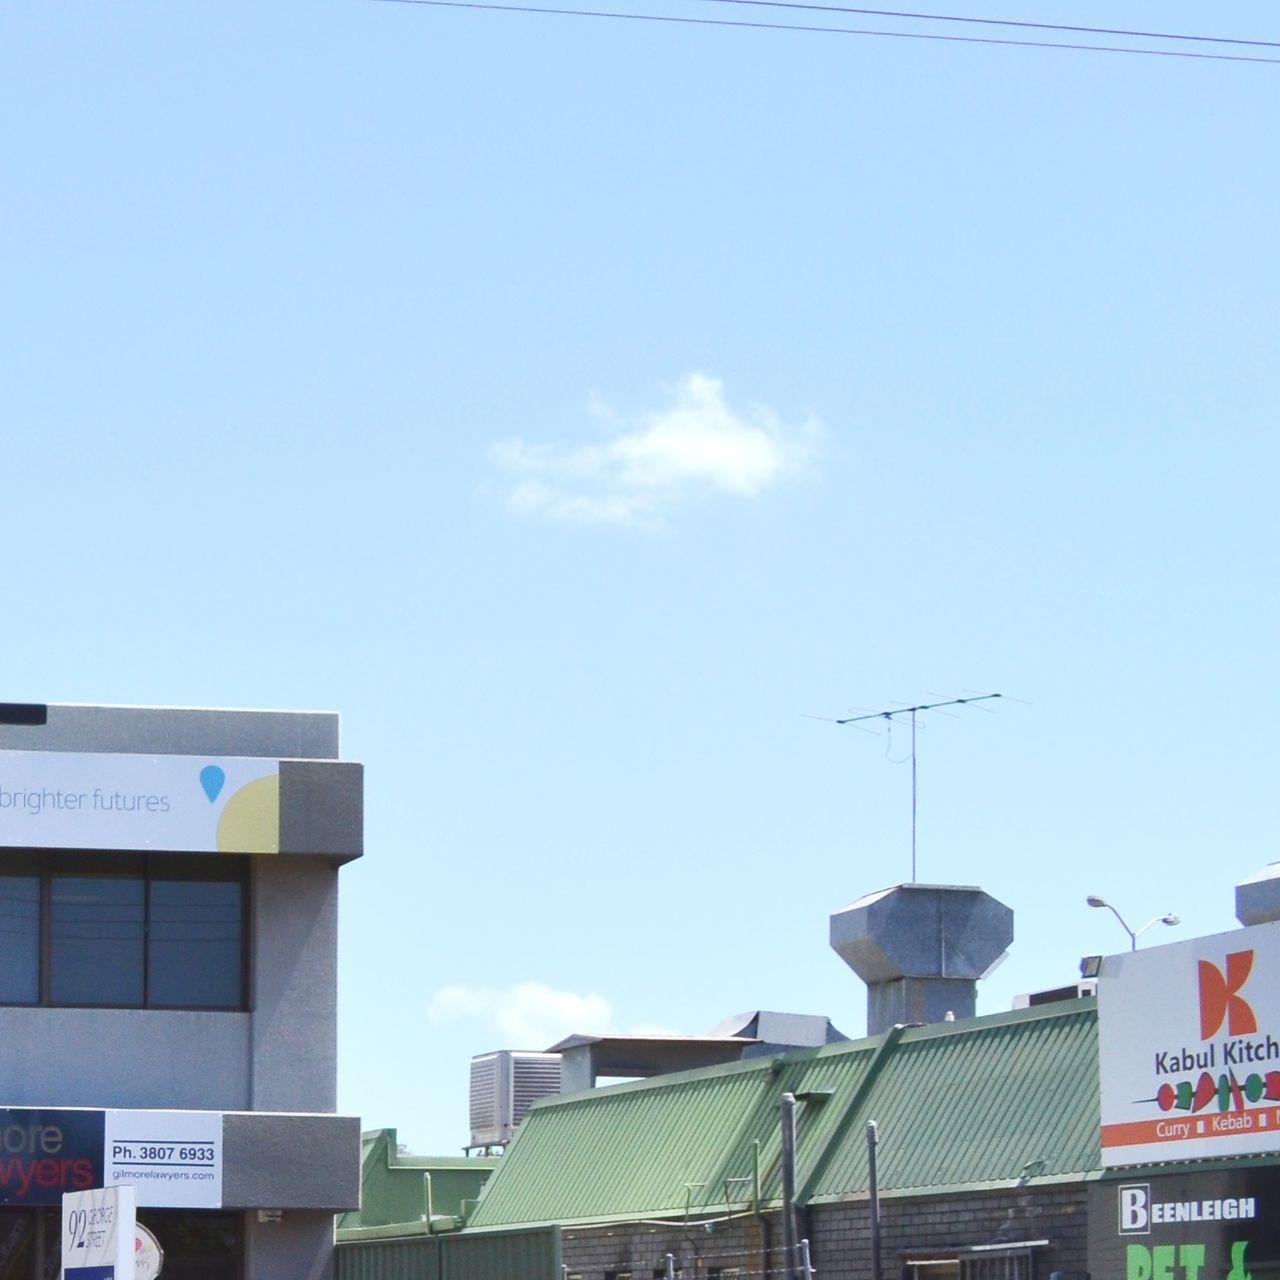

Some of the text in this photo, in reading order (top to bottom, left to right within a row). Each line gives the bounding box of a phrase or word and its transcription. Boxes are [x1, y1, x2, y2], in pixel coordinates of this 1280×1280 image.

[93, 788, 170, 812] futures
[1155, 1043, 1215, 1075] Kabul
[1156, 1114, 1252, 1137] Curry Kebab
[113, 1146, 215, 1161] Ph. 3807 6933
[112, 1169, 214, 1182] gilmorelawyers.com
[68, 1209, 87, 1251] 92
